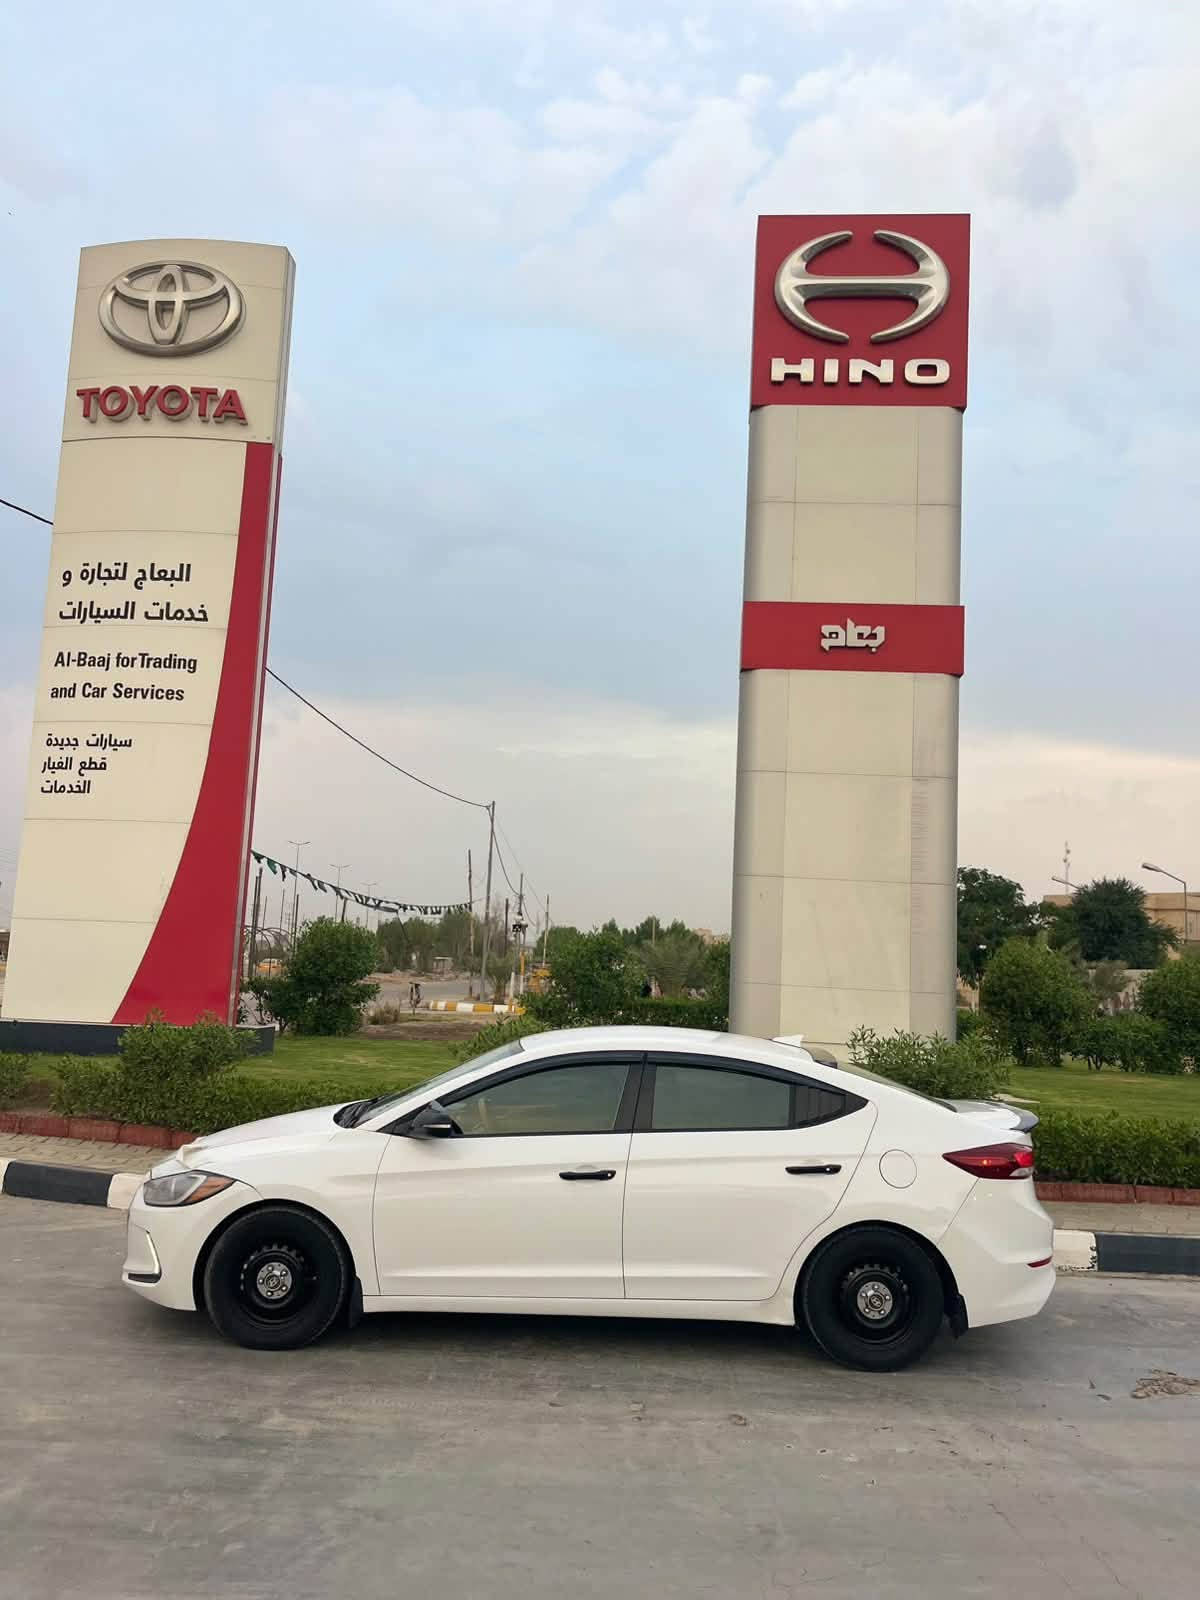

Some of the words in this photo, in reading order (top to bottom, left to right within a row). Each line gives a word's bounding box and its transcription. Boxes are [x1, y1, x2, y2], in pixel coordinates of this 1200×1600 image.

[770, 357, 951, 386] HINO
[76, 384, 248, 426] TOYOTA
[62, 570, 73, 588] و
[79, 561, 129, 586] لتجارة
[133, 562, 192, 590] البعاج
[58, 600, 136, 625] السيارات
[143, 601, 209, 623] خدمات
[53, 651, 111, 672] Al-Baaj
[115, 651, 138, 668] for
[137, 652, 198, 674] Trading
[50, 682, 77, 699] and
[81, 682, 108, 699] Car
[112, 682, 185, 701] Services
[45, 732, 80, 751] جديدة
[85, 733, 133, 752] سيارات
[41, 756, 73, 774] الغيار
[77, 756, 108, 777] قطع
[40, 779, 92, 794] الخدمات
